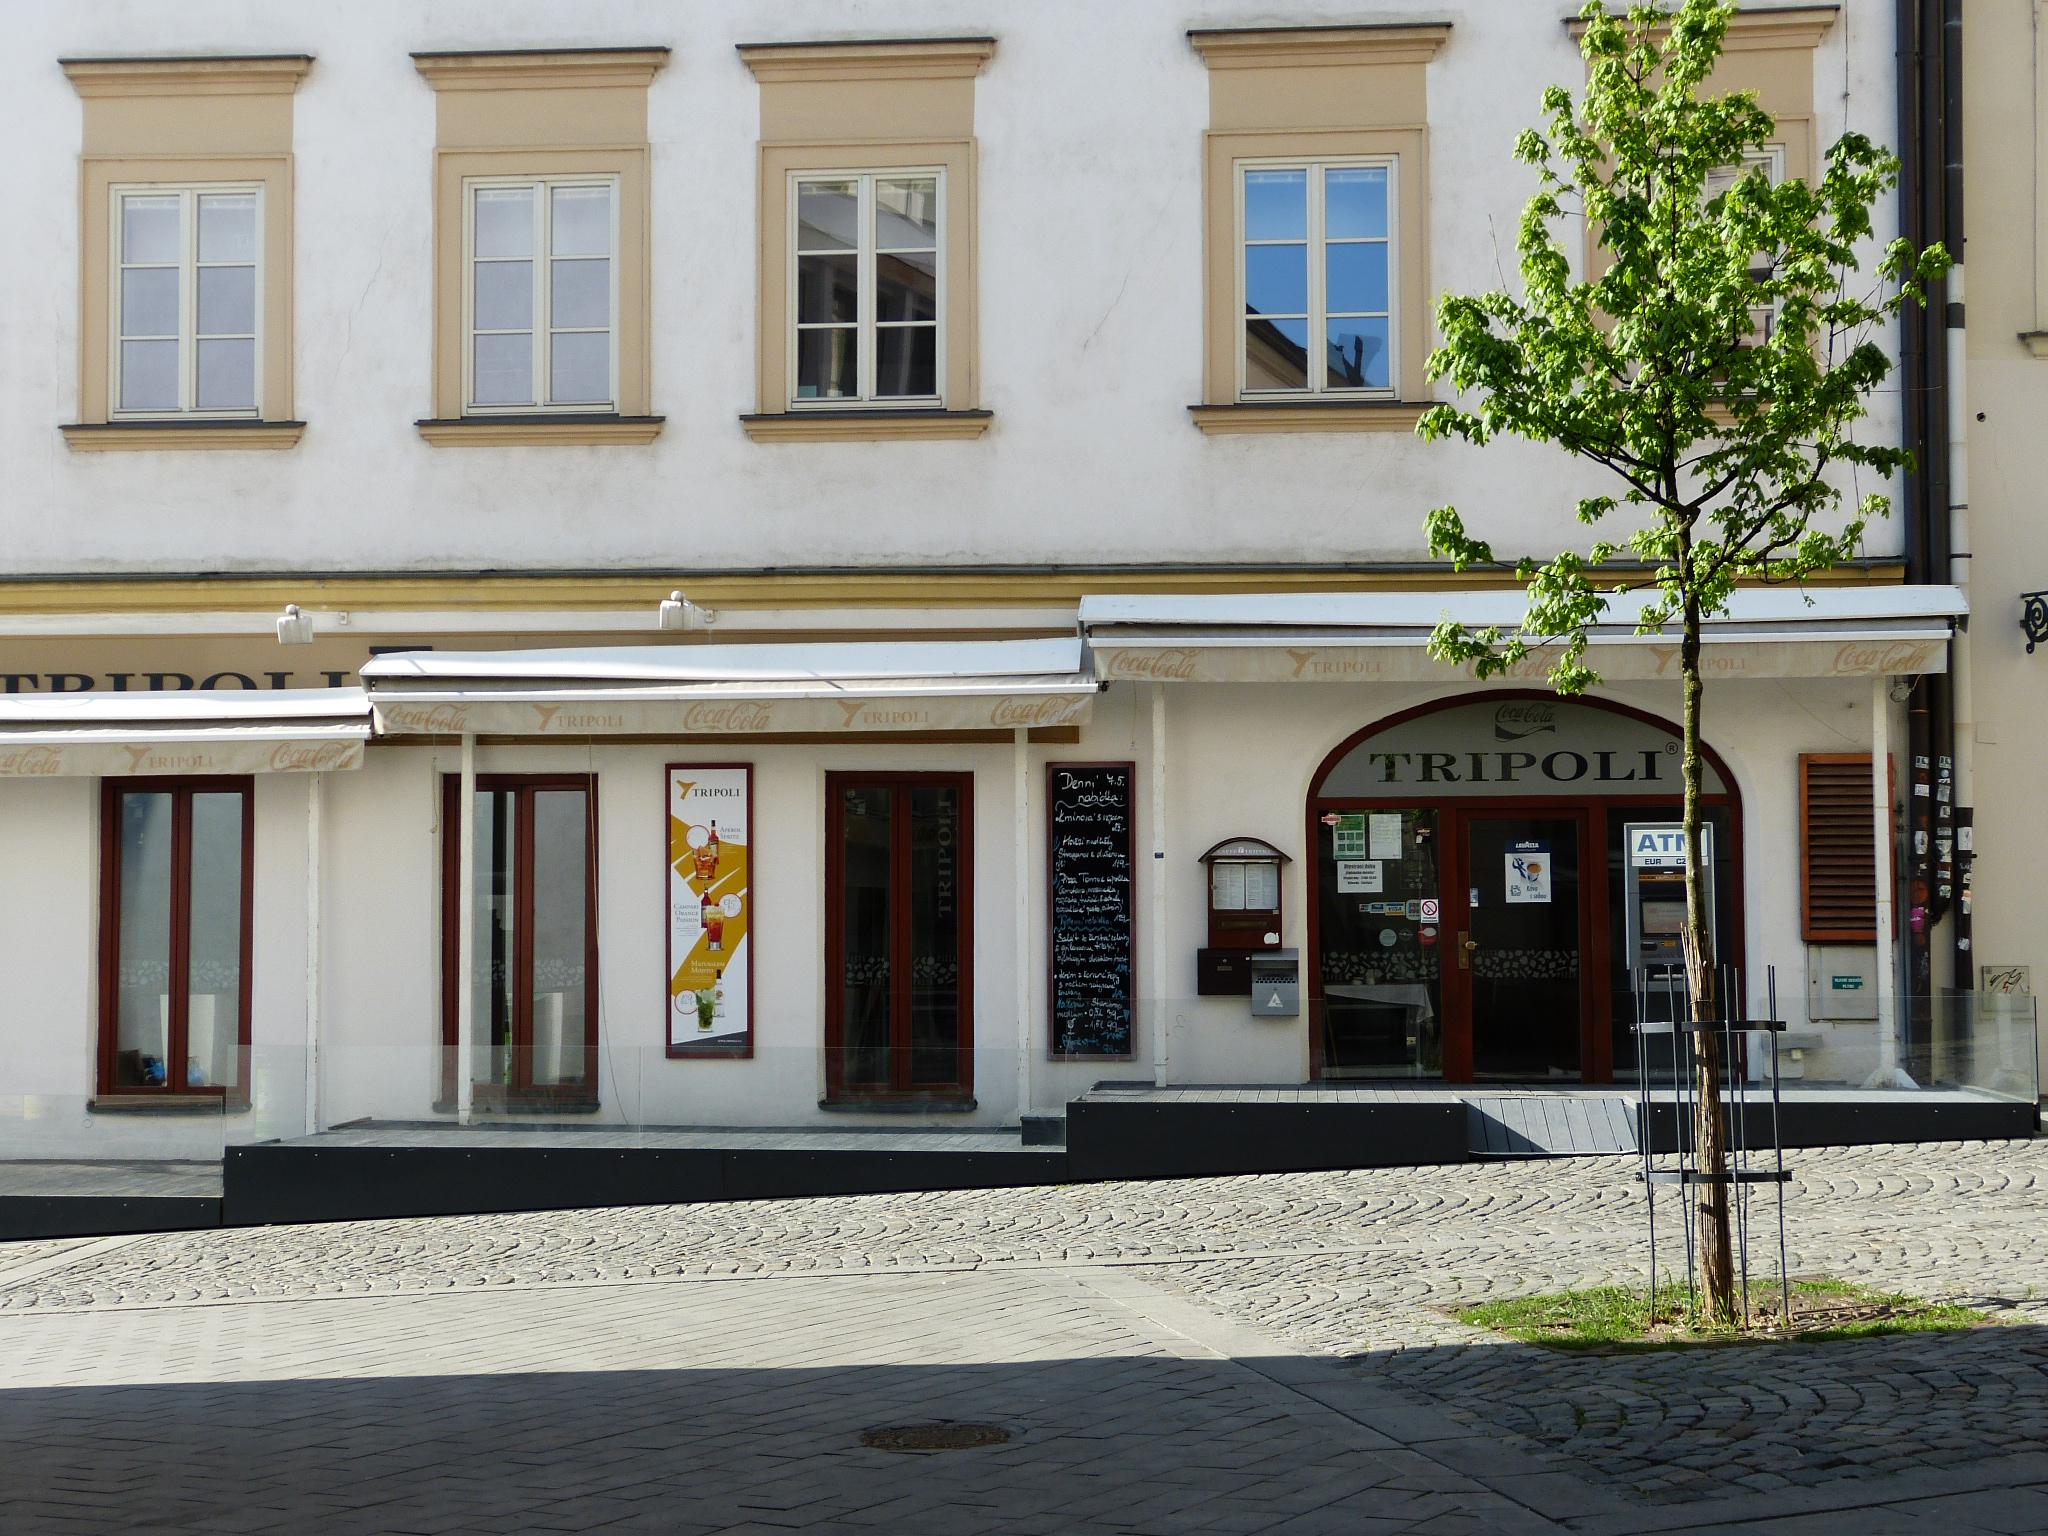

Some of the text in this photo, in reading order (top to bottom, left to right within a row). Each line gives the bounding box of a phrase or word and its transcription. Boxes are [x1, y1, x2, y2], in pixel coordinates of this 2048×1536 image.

[1311, 661, 1383, 674] TRIPOLI
[557, 714, 624, 728] TRIPOLI
[864, 710, 929, 725] TRIPOLI
[149, 755, 214, 769] TRIPOLI
[1369, 751, 1663, 782] TRIPOLI
[692, 788, 740, 797] TRIPOLI
[937, 800, 952, 918] TRIPOLI
